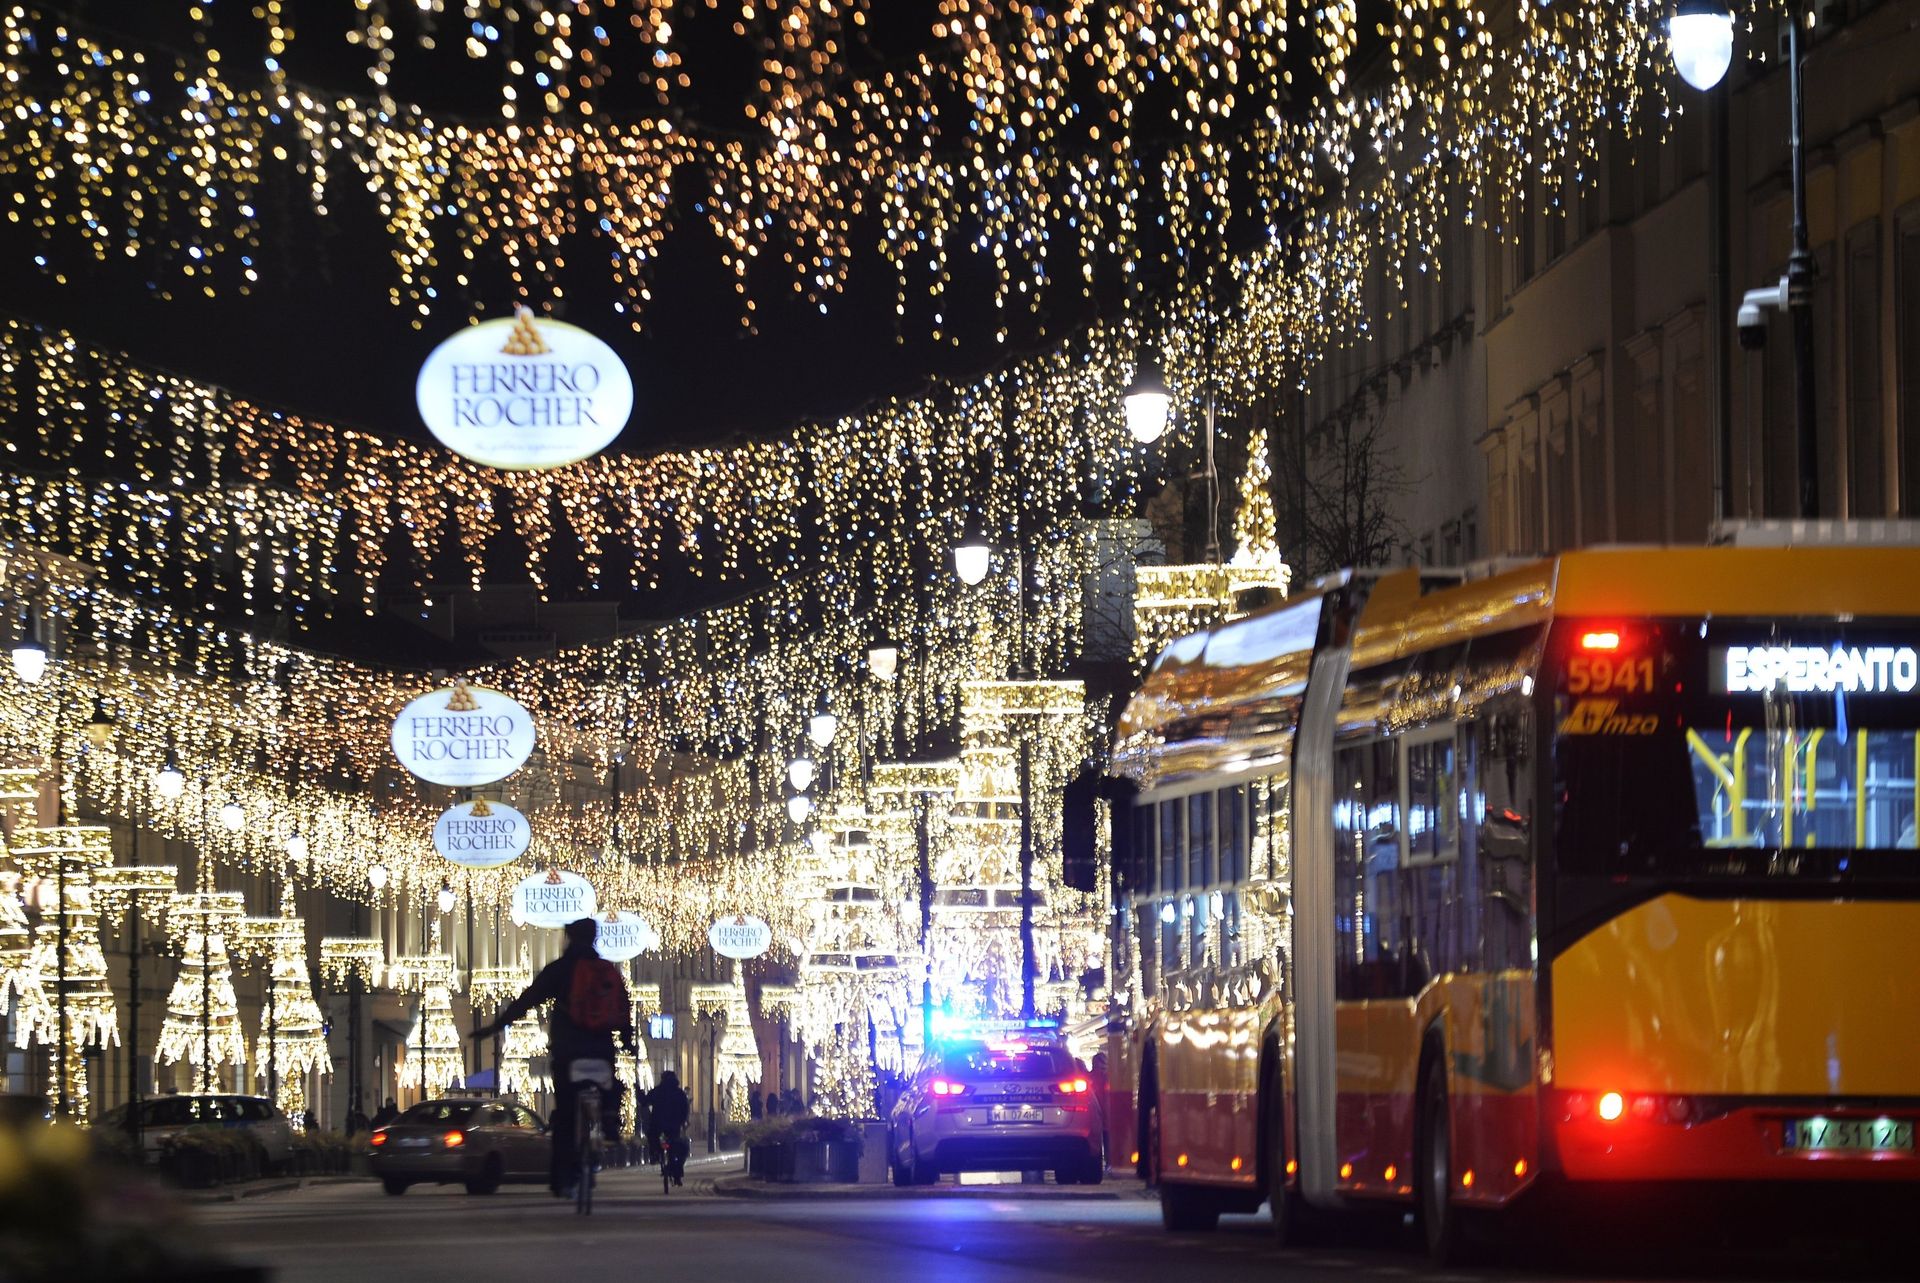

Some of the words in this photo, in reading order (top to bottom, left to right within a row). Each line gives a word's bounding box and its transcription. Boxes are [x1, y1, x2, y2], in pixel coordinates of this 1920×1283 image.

[452, 362, 600, 393] FERRERO
[453, 396, 599, 427] ROCHER
[1568, 657, 1654, 694] 5941
[1726, 646, 1917, 692] ESPERANTO
[412, 715, 514, 738] FERRERO
[412, 738, 514, 761] ROCHER
[447, 818, 516, 835] FERRERO
[448, 835, 516, 851] ROCHER
[525, 886, 584, 900] FERRERO
[525, 900, 584, 913] ROCHER
[718, 927, 762, 937] FERRERO
[592, 936, 640, 948] OCHER
[718, 937, 762, 947] ROCHER
